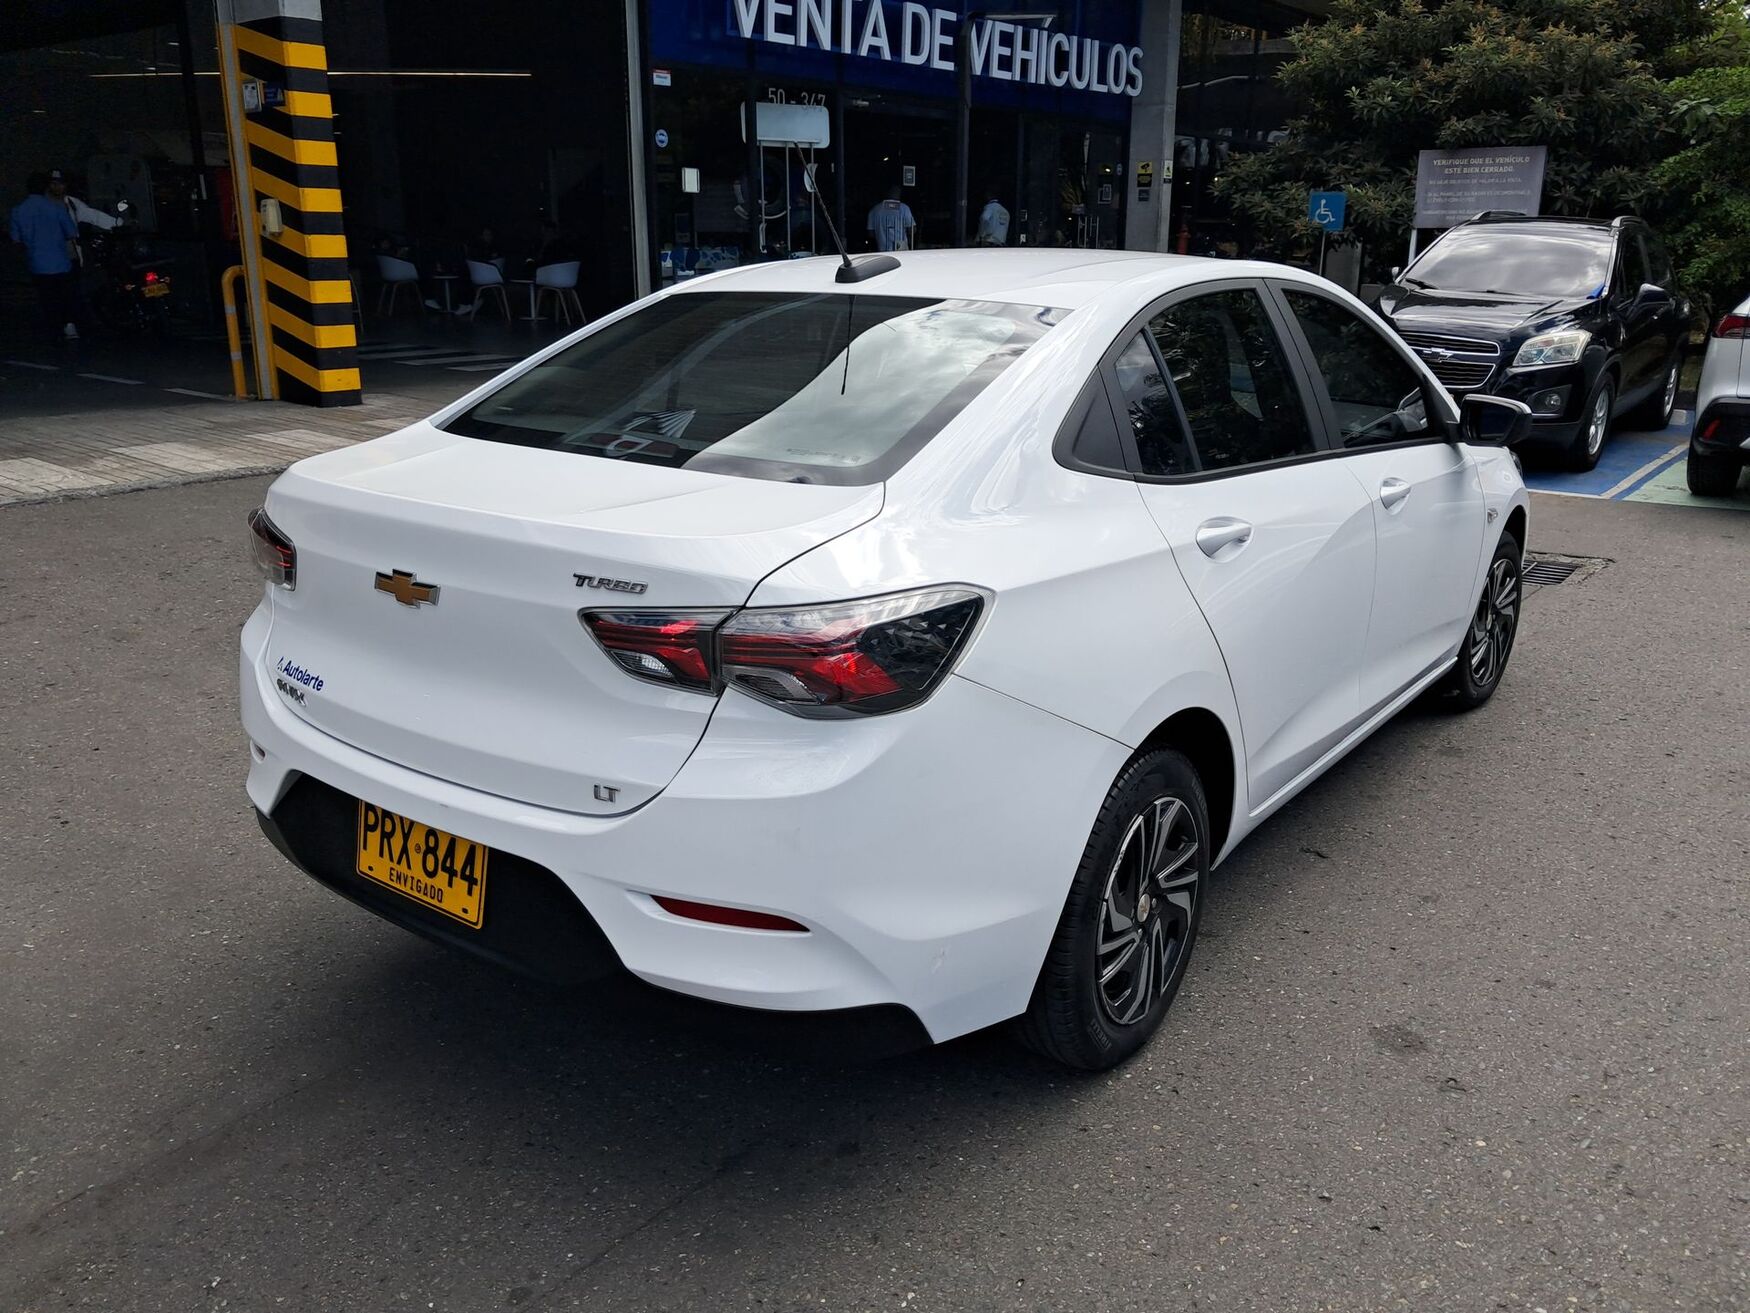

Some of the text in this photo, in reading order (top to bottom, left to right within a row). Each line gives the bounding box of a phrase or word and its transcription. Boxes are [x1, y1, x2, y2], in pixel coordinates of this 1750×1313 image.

[734, 0, 1144, 97] VENTA DE VEHÍCULOS
[768, 88, 786, 104] 50
[1463, 166, 1480, 174] BIEN
[1470, 157, 1483, 165] QUE
[1495, 155, 1530, 163] VEHÍCULO
[573, 572, 648, 594] TURBO
[282, 660, 324, 691] Autolarte
[594, 784, 621, 804] LT
[363, 803, 478, 897] PRX 844
[389, 867, 443, 903] ENVIGADO
